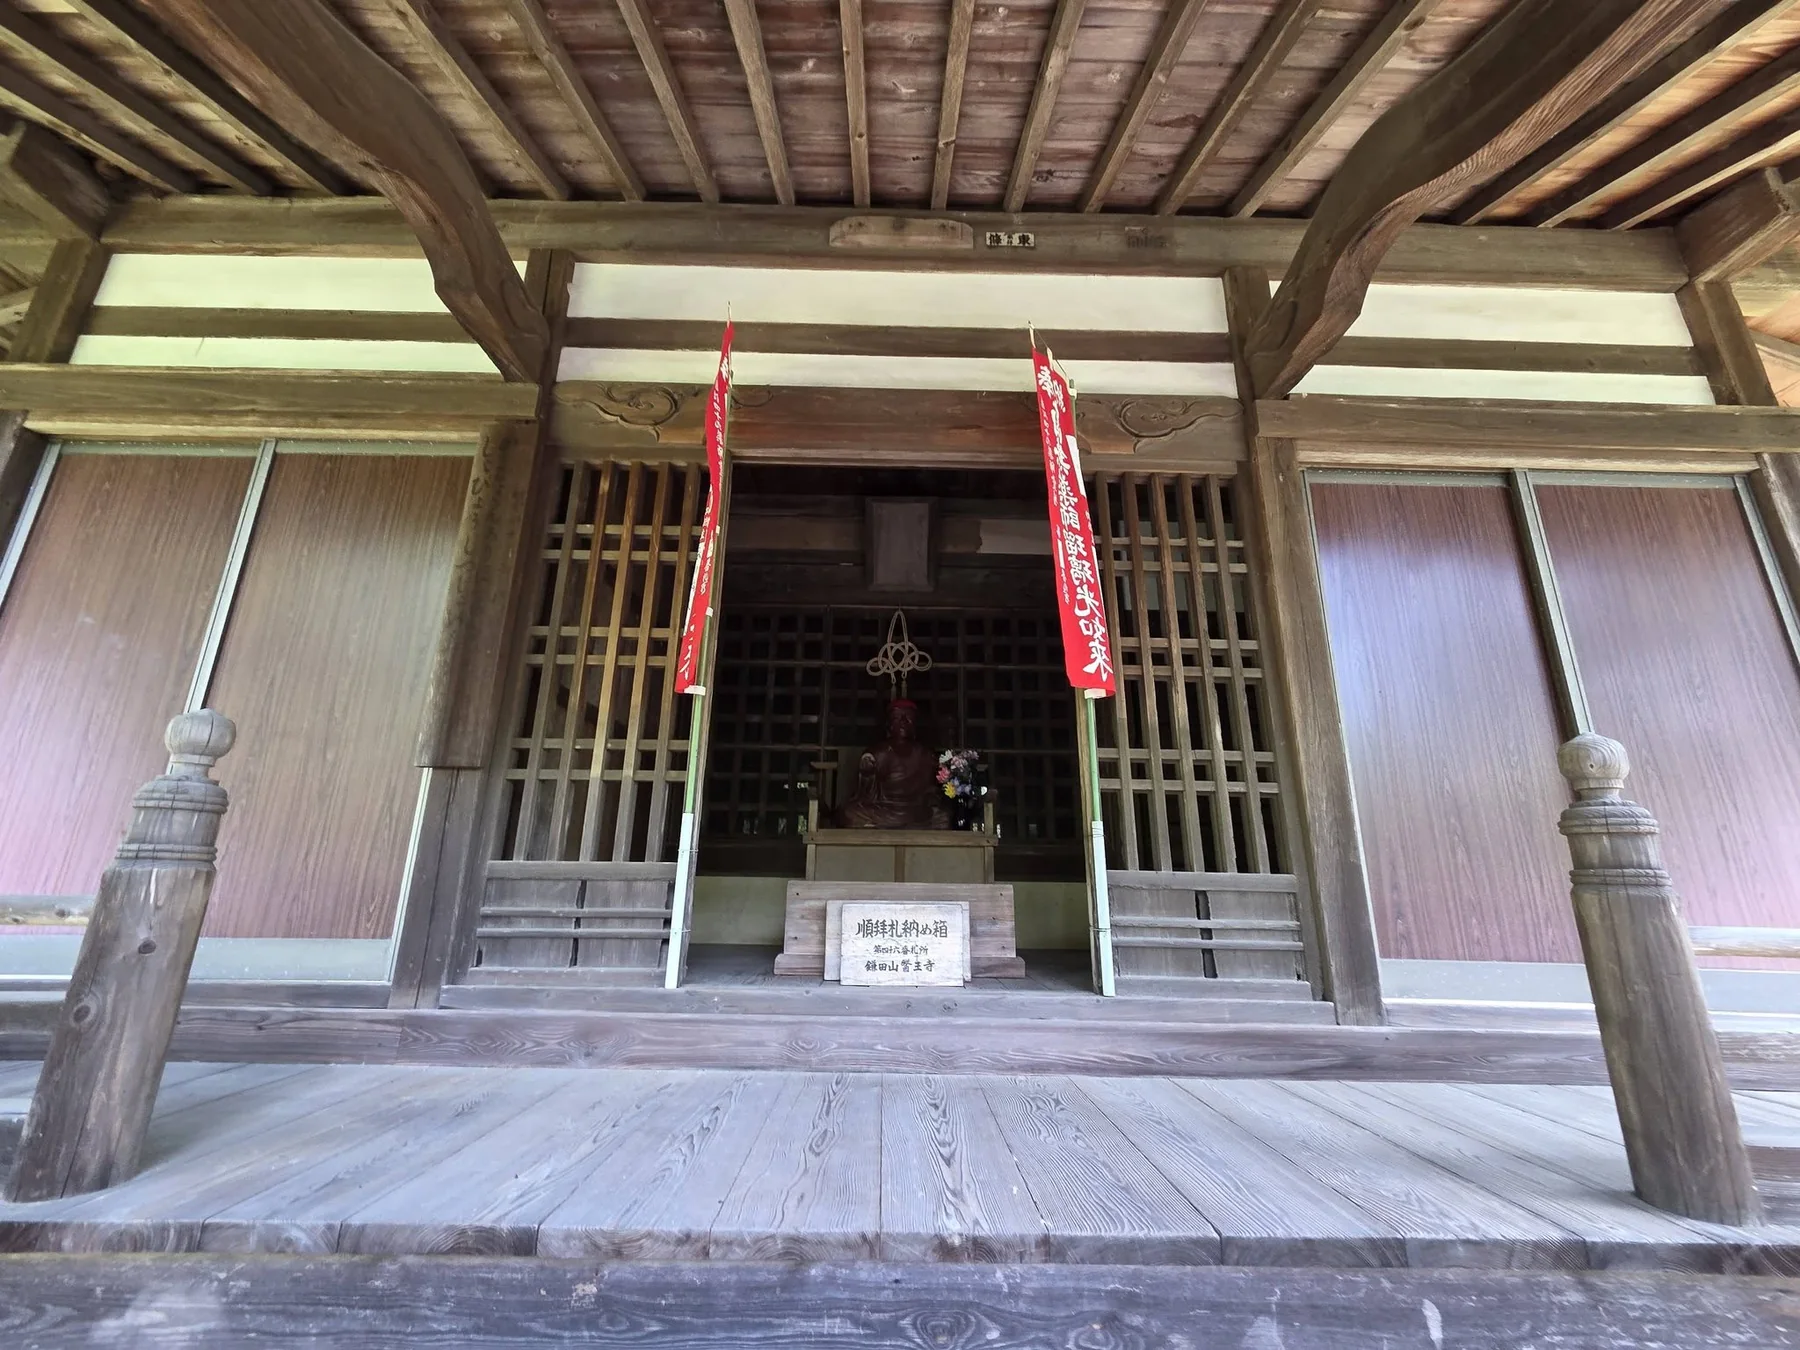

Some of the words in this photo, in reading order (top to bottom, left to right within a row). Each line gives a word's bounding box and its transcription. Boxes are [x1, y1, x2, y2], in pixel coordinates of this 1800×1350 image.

[855, 918, 948, 938] 順拝札納め箱
[873, 944, 929, 955] 第四十六番札所
